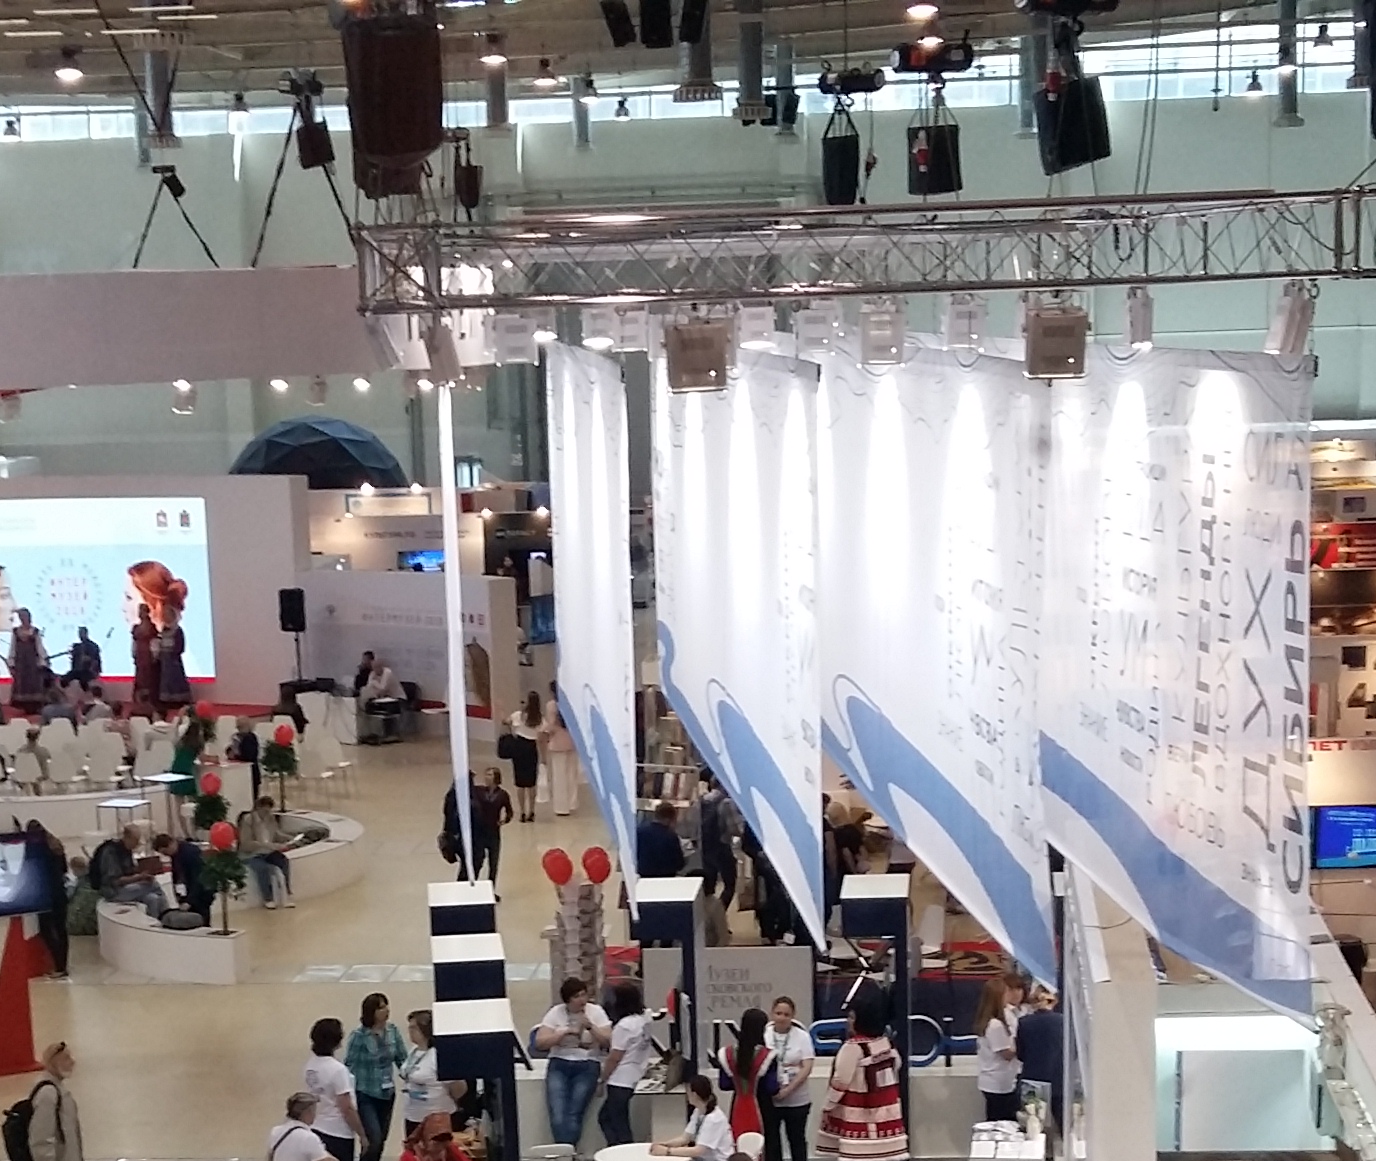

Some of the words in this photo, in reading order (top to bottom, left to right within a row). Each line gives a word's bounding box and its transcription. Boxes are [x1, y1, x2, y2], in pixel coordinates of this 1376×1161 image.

[1192, 452, 1217, 785] ЛЕГЕНДЫ
[1241, 567, 1277, 854] ДУХ
[1282, 518, 1307, 895] СИБИРЬ
